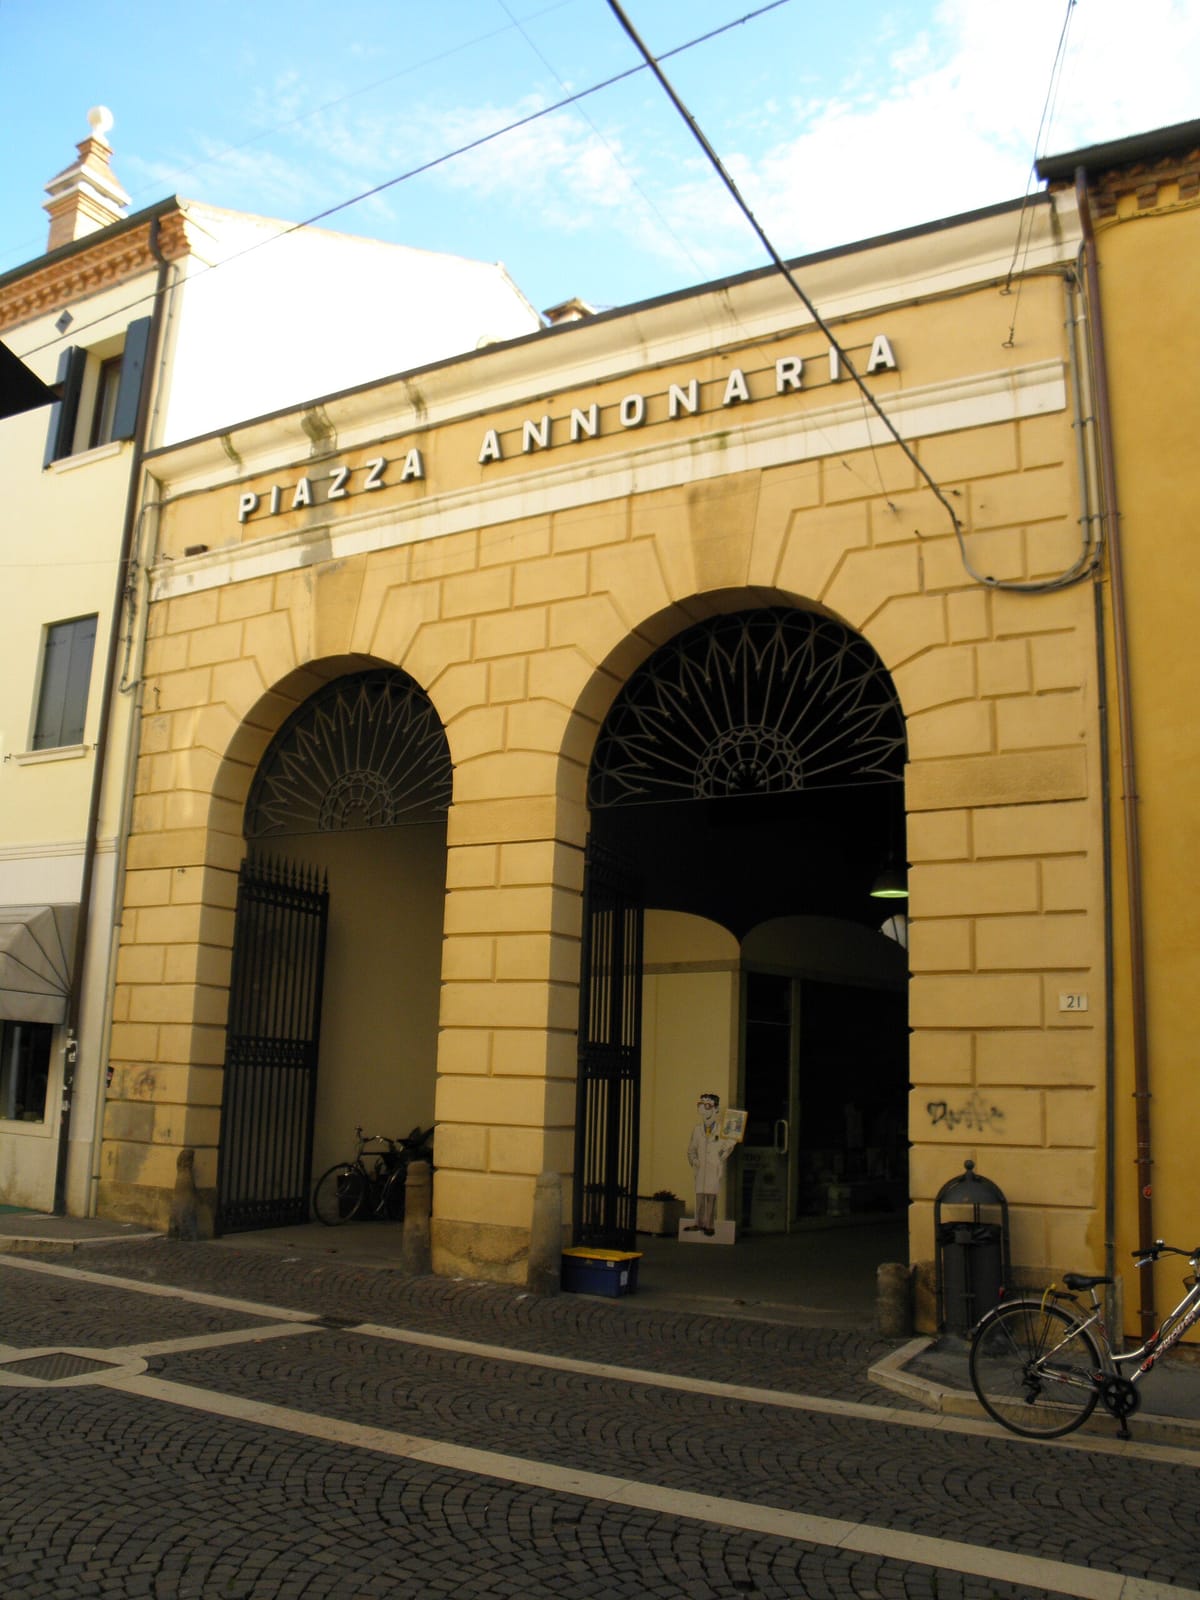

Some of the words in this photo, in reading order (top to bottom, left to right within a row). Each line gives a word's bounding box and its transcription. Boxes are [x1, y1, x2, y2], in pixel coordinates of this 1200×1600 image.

[237, 447, 425, 524] PIAZZA
[478, 335, 898, 465] ANNONARIA
[1066, 995, 1081, 1009] 21
